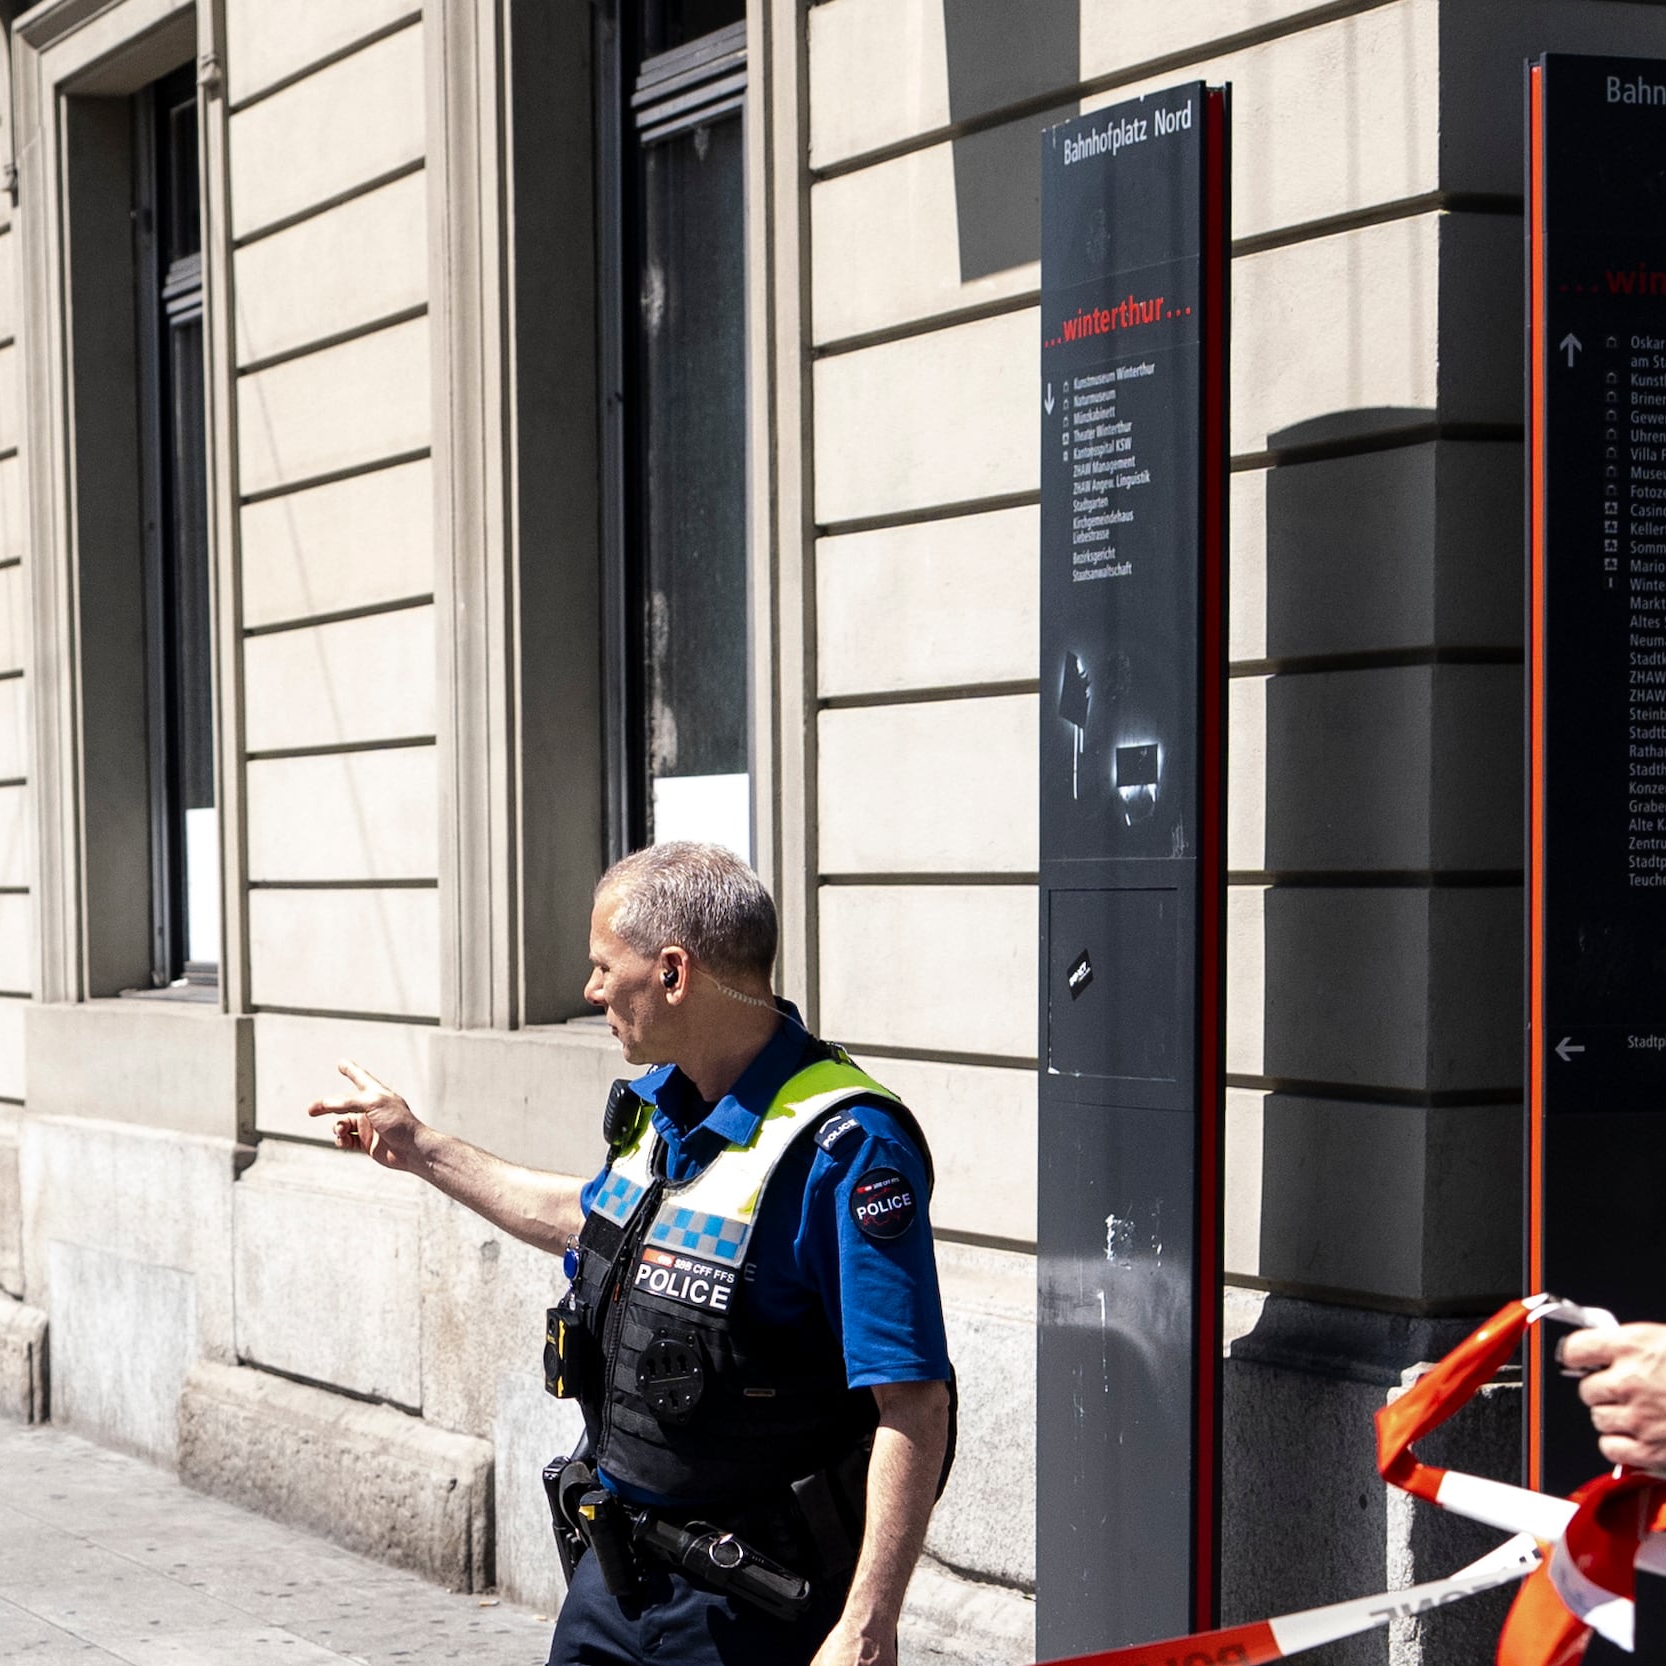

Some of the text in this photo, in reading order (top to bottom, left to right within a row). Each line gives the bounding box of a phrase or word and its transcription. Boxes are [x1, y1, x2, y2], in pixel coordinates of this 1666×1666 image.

[1063, 100, 1192, 165] Bahnhofplatz Nord
[1630, 336, 1664, 349] Oskar
[1630, 358, 1649, 367] am
[1073, 362, 1155, 390] Kunstmuseum Winterthur
[1630, 392, 1666, 405] Briner
[1073, 420, 1132, 442] Theater Winterthur
[1116, 437, 1132, 452] KSW
[1630, 448, 1656, 460] Villa
[1092, 455, 1135, 475] Management
[1116, 469, 1150, 489] Linguistik
[1073, 496, 1108, 514] Stadtgarten
[1073, 509, 1134, 531] Kirchgemeindehaus
[1073, 528, 1110, 544] Liebestrasse
[1073, 546, 1116, 566] Bezirksgericht
[1073, 561, 1132, 582] Staatsanwaltschaft
[1629, 616, 1660, 628] Altes
[1629, 671, 1666, 683] ZHAW
[1629, 689, 1666, 701] ZHAW
[1628, 818, 1653, 830] Alte
[822, 1118, 858, 1148] POLICE
[856, 1192, 912, 1220] POLICE
[674, 1258, 735, 1284] SBB CFF FFS
[634, 1262, 731, 1311] POLICE
